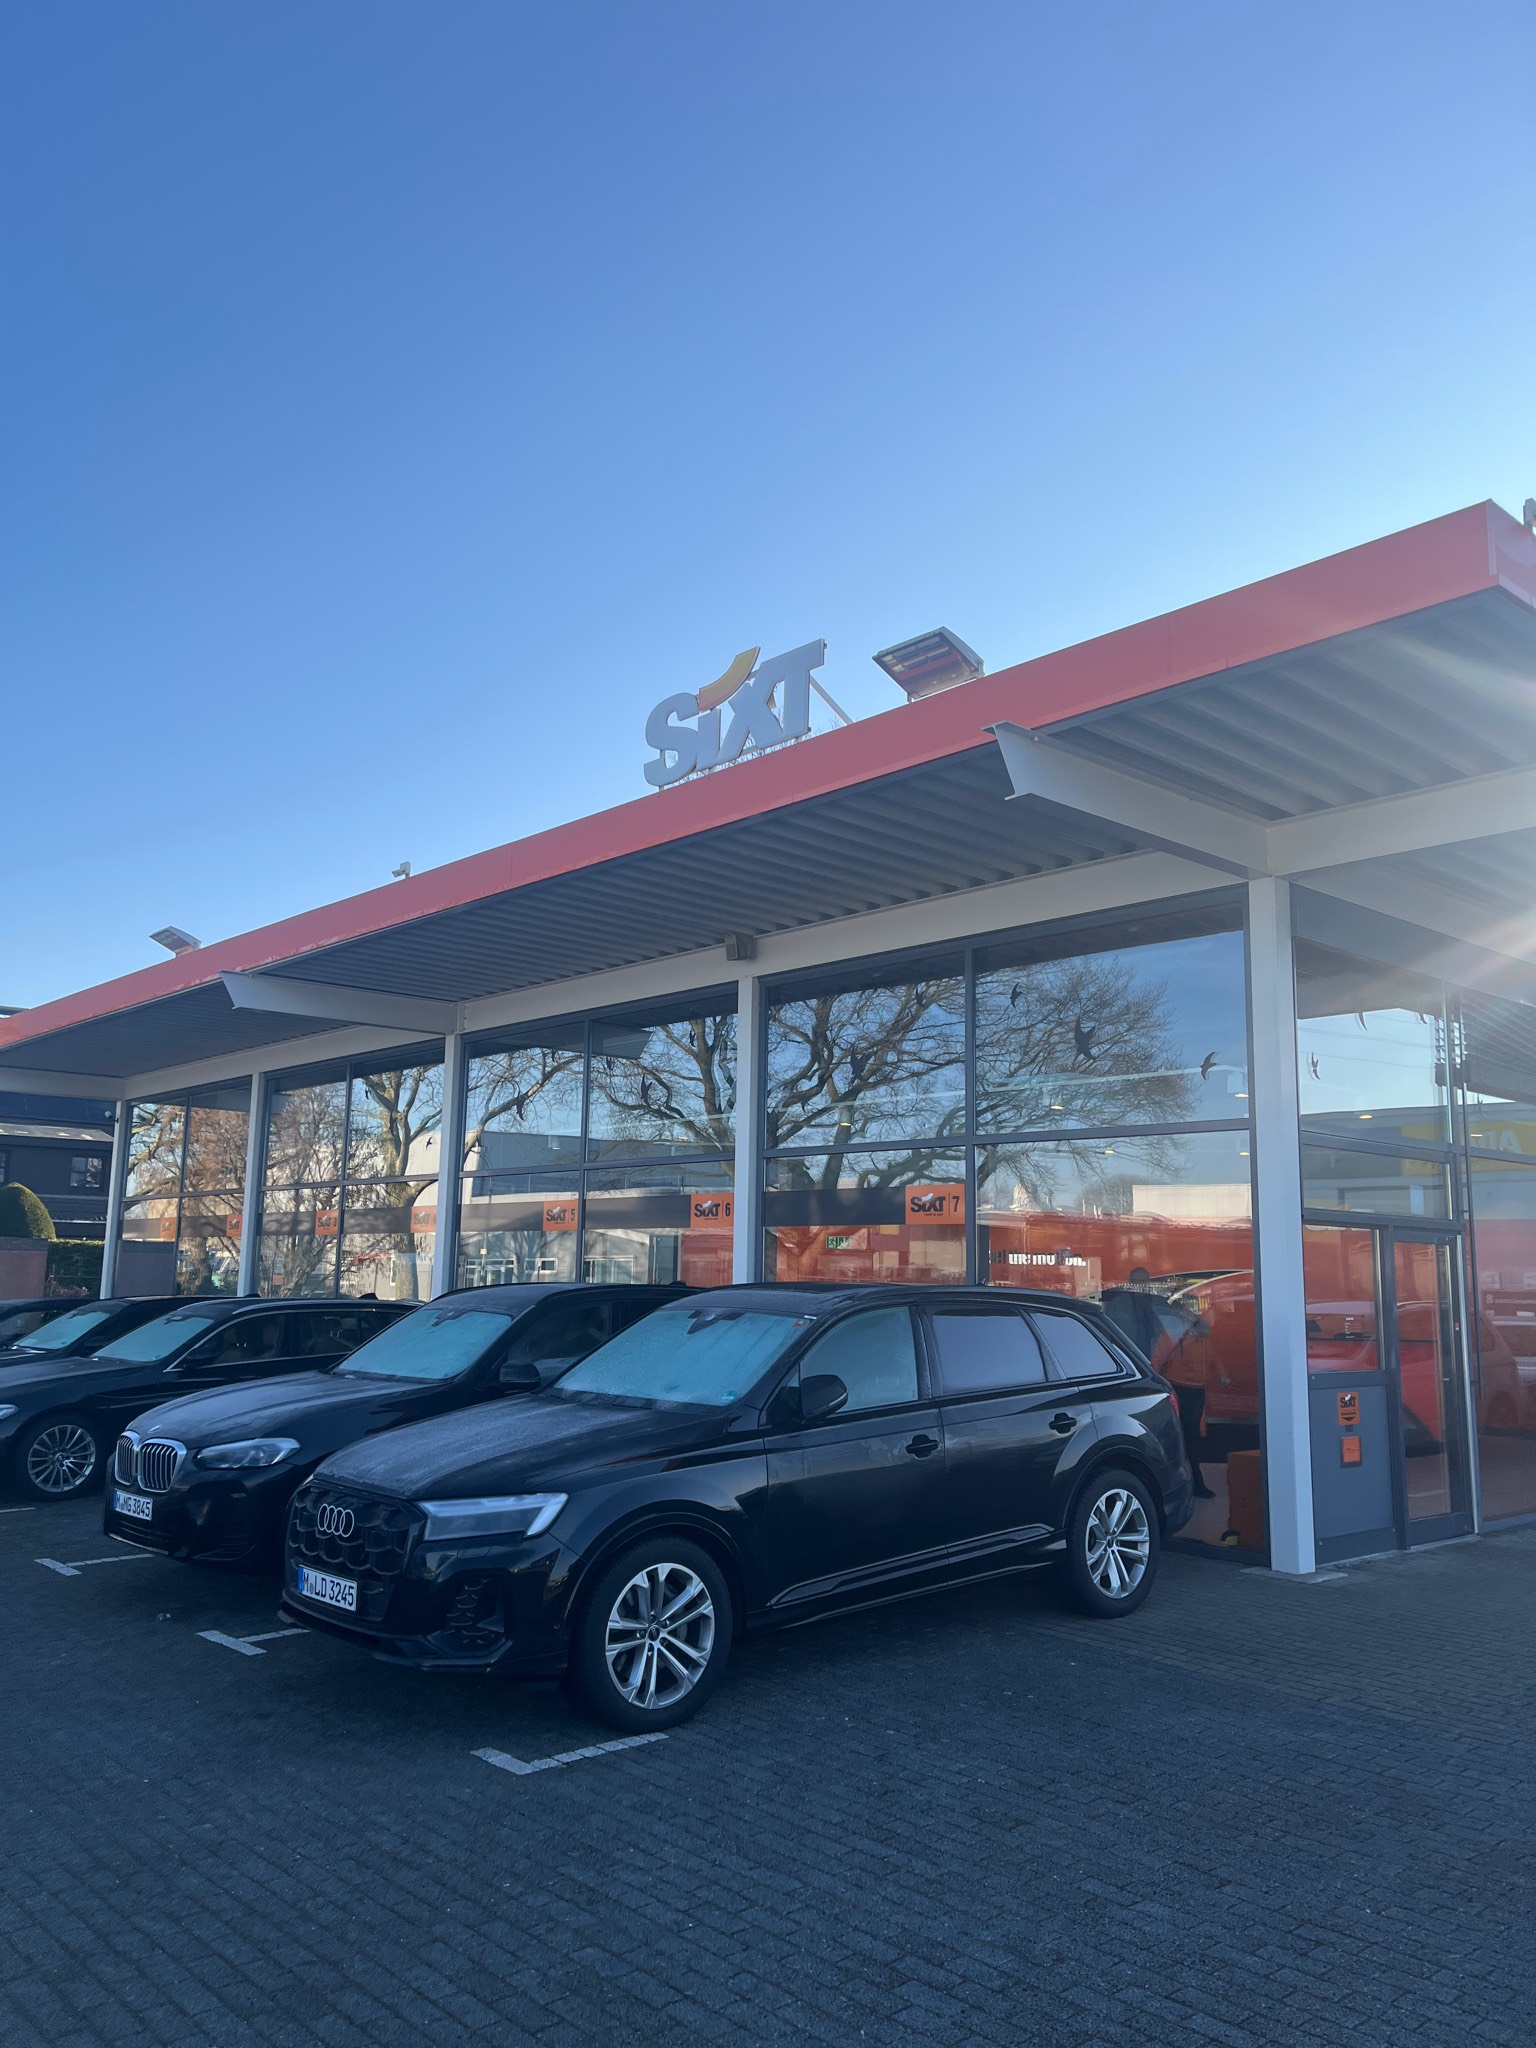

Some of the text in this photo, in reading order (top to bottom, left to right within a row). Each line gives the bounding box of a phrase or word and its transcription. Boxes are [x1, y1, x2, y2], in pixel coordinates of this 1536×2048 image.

[725, 1202, 731, 1217] 6
[952, 1196, 960, 1212] 7
[570, 1208, 576, 1222] 5
[133, 1498, 151, 1518] 3845
[303, 1571, 355, 1607] M LD 3245
